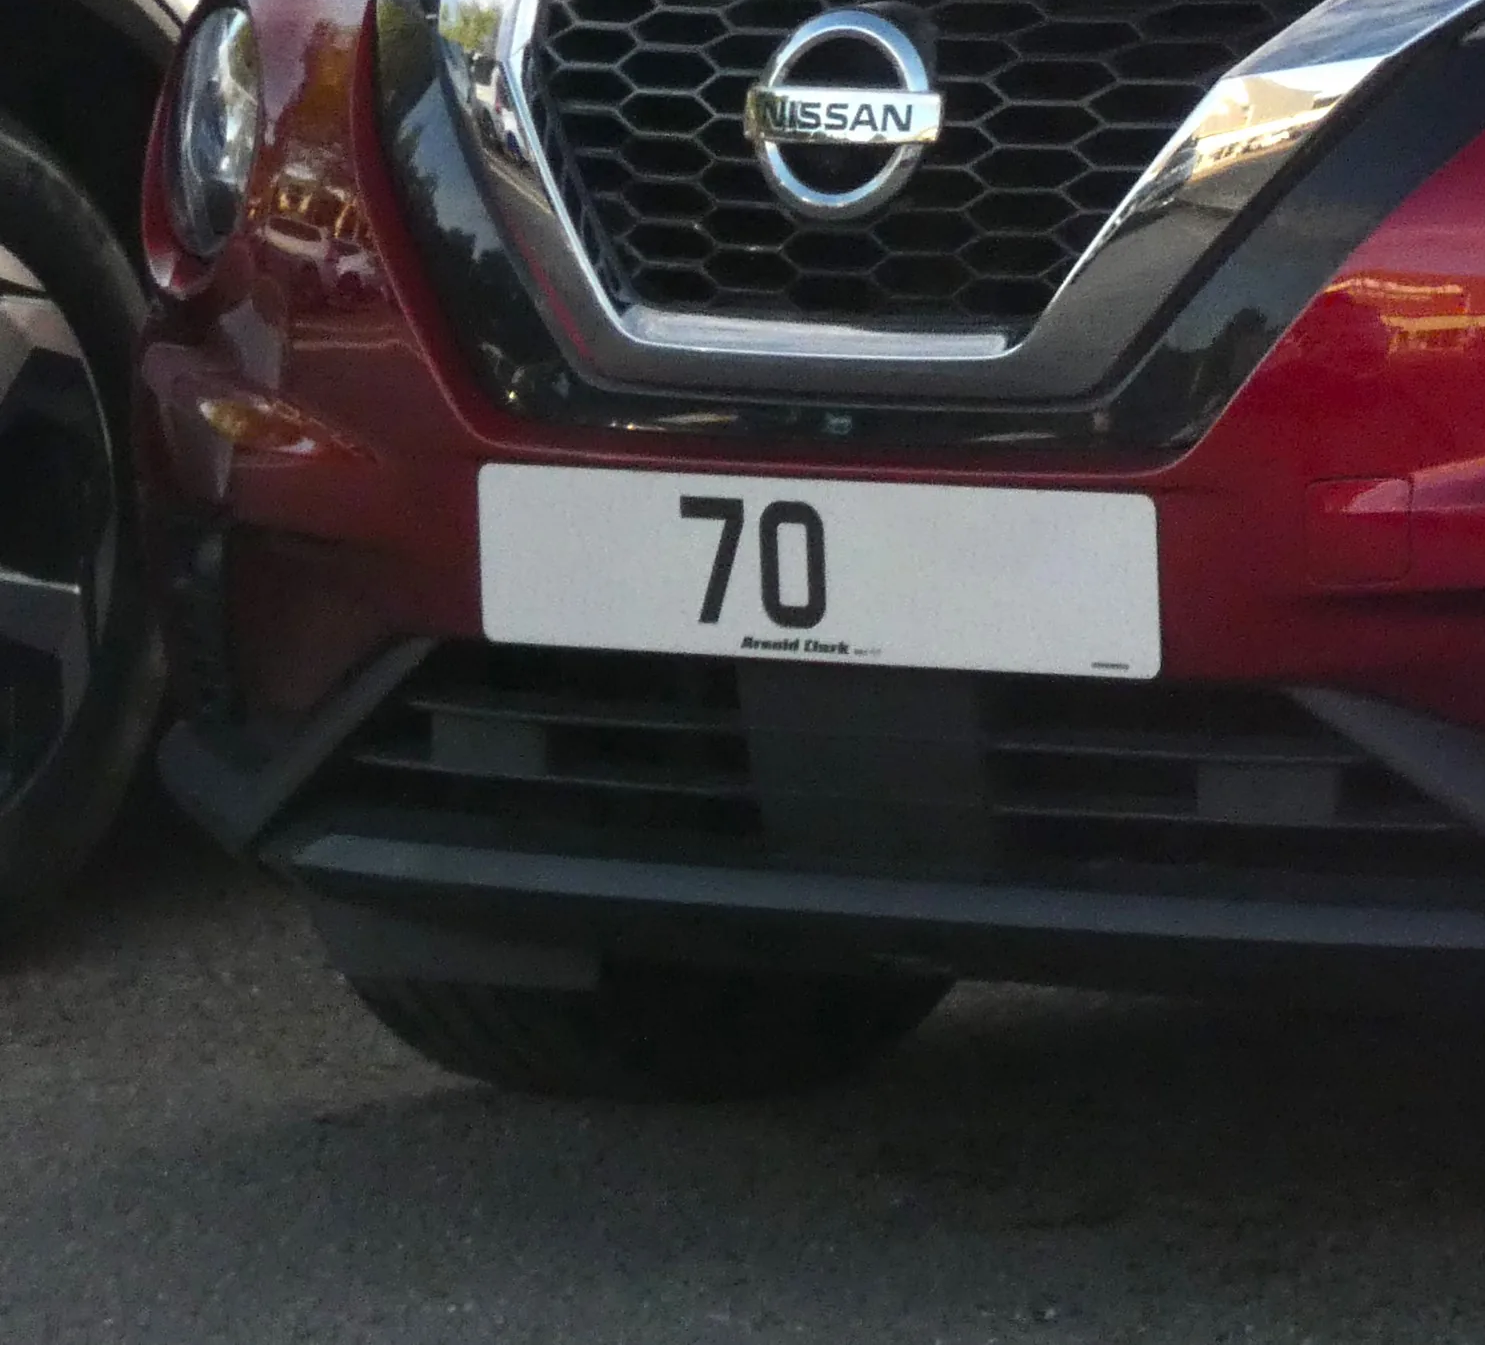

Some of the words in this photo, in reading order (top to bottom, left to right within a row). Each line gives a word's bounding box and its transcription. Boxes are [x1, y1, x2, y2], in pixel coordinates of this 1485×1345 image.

[761, 99, 913, 132] NISSAN
[680, 496, 826, 629] 70
[803, 639, 850, 655] Clark
